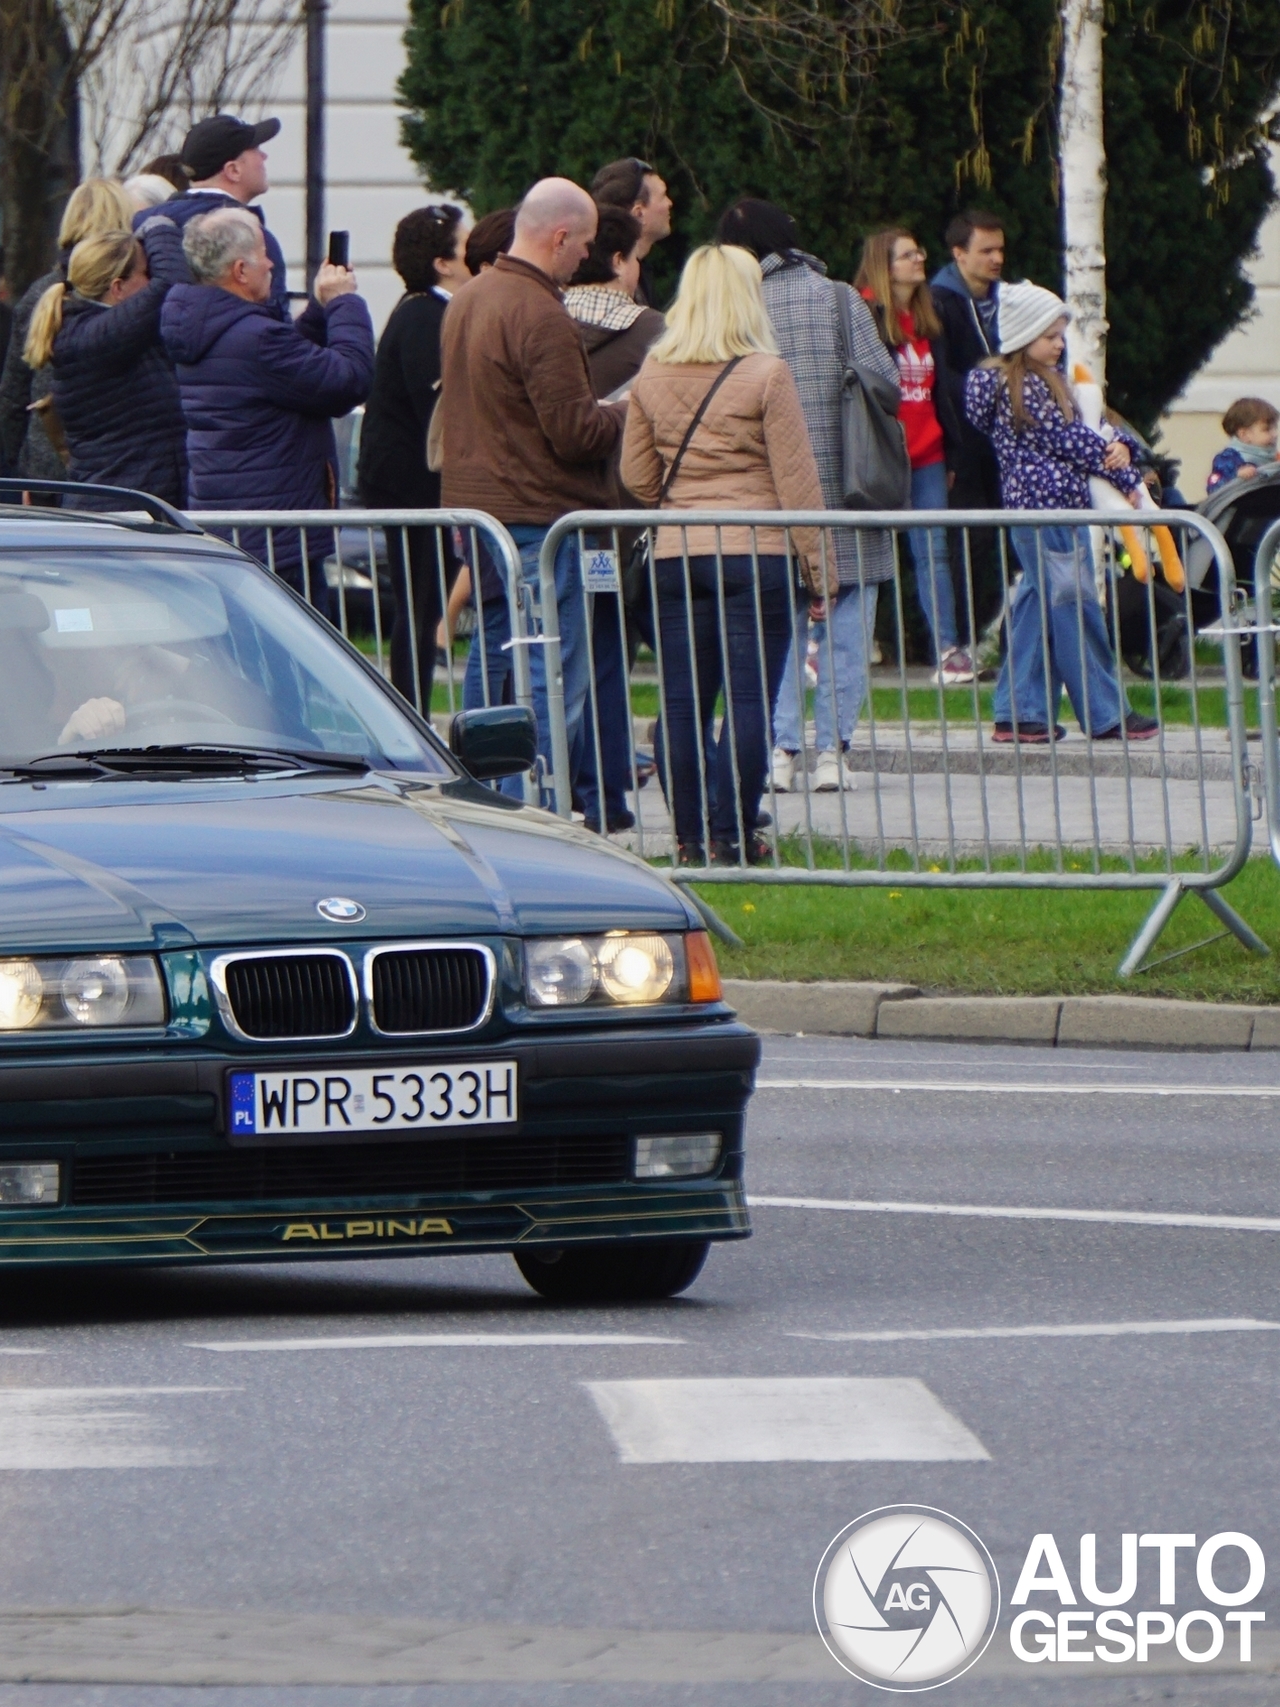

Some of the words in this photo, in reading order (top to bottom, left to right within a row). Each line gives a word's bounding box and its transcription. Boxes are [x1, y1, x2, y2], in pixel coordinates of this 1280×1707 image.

[261, 1077, 351, 1128] WPR
[372, 1068, 513, 1124] 5333H
[235, 1111, 253, 1125] PL
[282, 1217, 454, 1241] ALPINA
